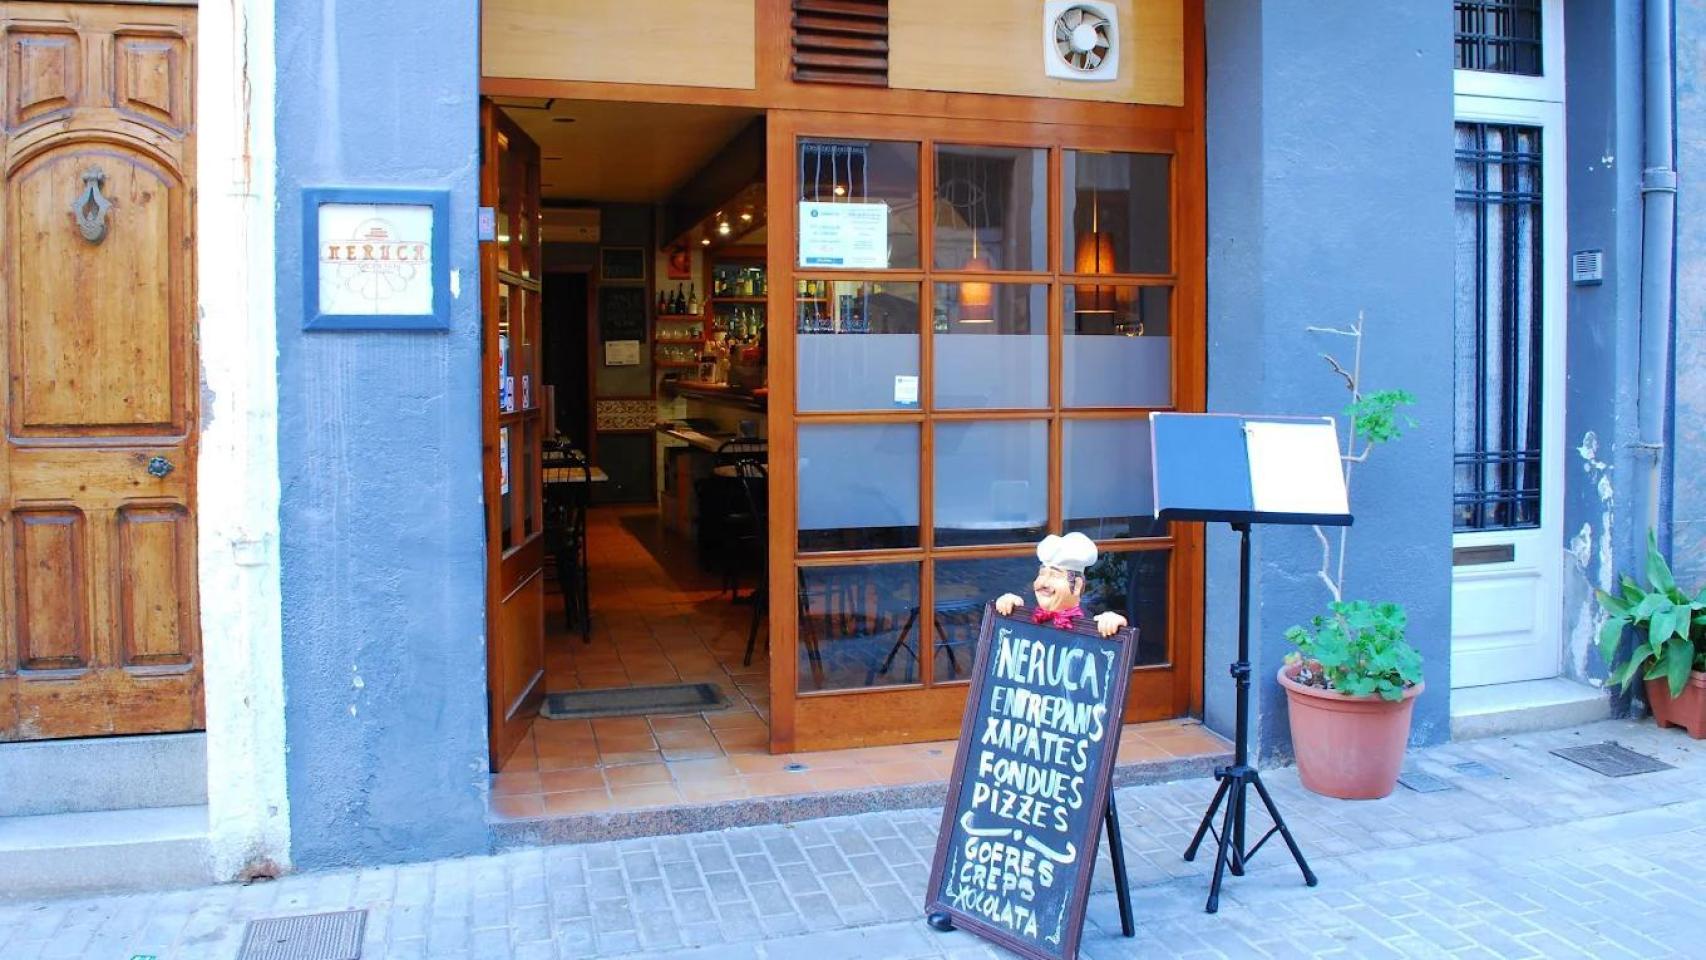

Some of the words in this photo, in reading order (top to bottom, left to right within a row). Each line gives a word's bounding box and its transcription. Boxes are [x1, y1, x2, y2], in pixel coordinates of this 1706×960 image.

[328, 244, 425, 260] NERUCA
[996, 637, 1099, 699] NERUCA
[990, 685, 1106, 742] ENTREPANS
[981, 717, 1088, 772] XAPATES
[978, 750, 1084, 809] FONDUES
[960, 861, 1035, 902] CREPS
[964, 837, 1054, 888] GOFRES
[953, 883, 1039, 938] XOCOLATA
